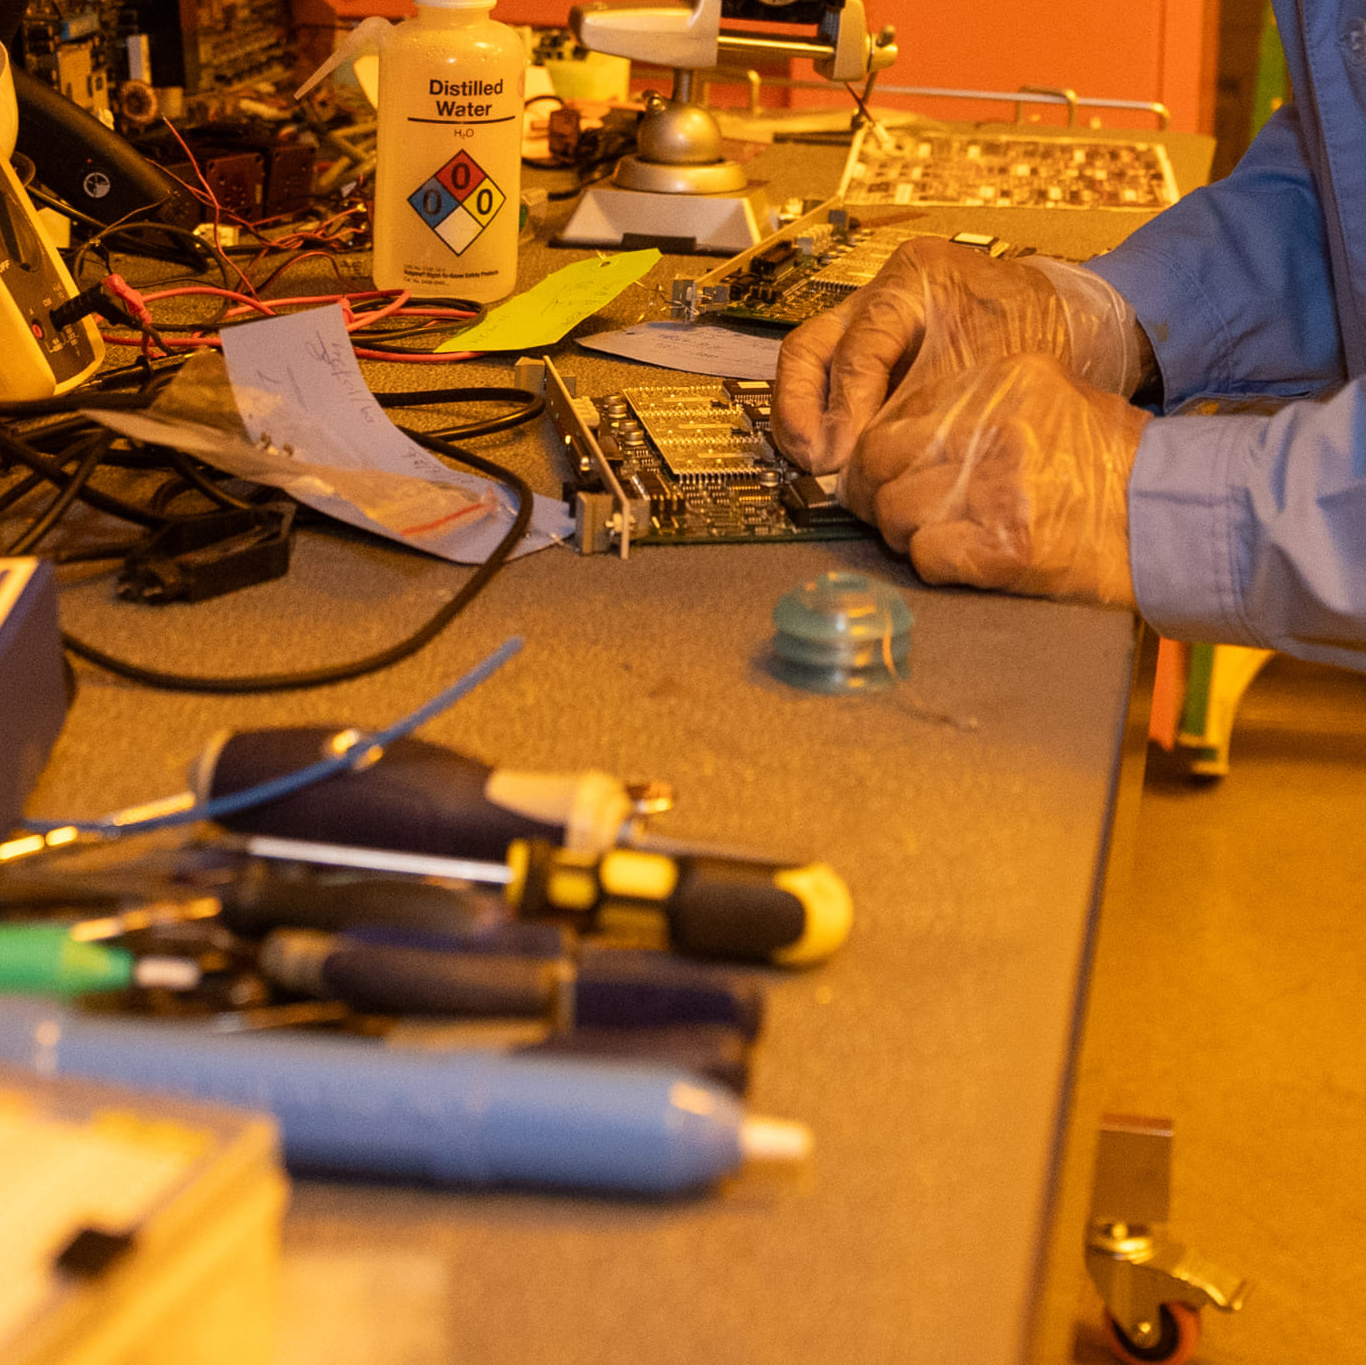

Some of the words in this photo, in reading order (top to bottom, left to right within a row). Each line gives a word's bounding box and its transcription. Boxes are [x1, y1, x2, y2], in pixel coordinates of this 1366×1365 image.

[429, 78, 503, 96] Distilled
[436, 100, 492, 117] Water
[451, 162, 471, 190] 0
[423, 189, 442, 215] 0
[476, 188, 493, 215] 0
